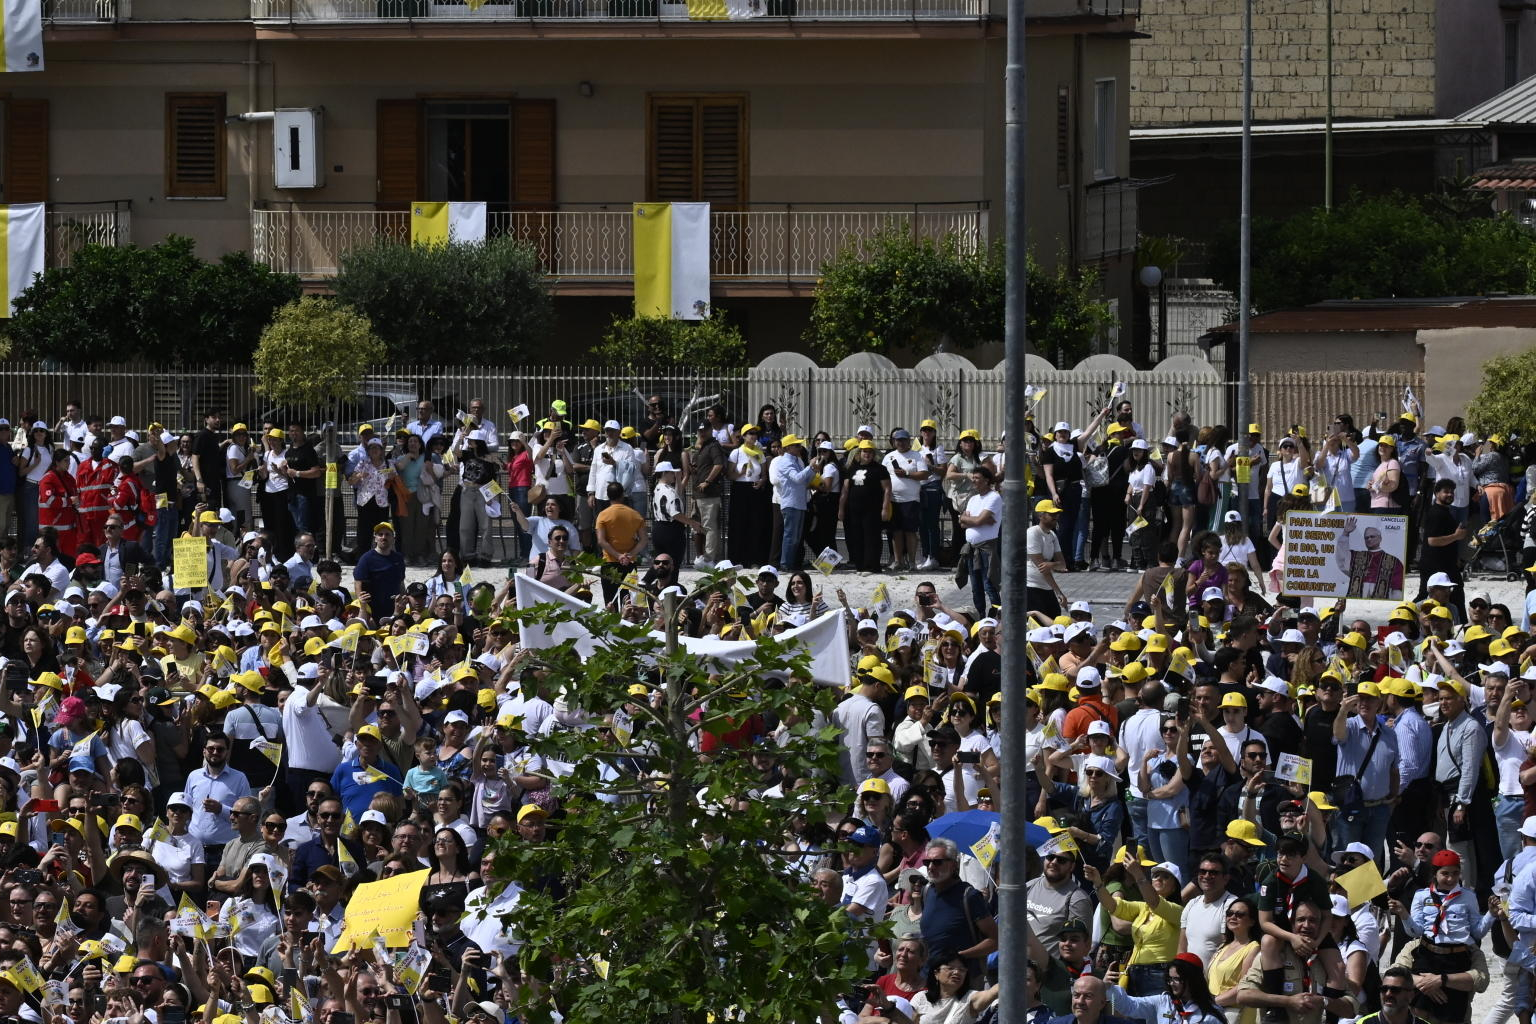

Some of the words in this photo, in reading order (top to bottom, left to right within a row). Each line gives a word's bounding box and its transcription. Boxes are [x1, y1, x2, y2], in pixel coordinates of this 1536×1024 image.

[1290, 517, 1313, 527] PAPA
[1315, 518, 1345, 528] LEONE
[1289, 530, 1303, 539] UN
[1304, 531, 1335, 541] SERVO
[1288, 543, 1298, 551] DI
[1300, 543, 1319, 554] DIO,
[1321, 544, 1335, 553] UN
[1288, 555, 1325, 566] GRANDE
[1287, 568, 1306, 578] PER
[1307, 569, 1319, 578] LA
